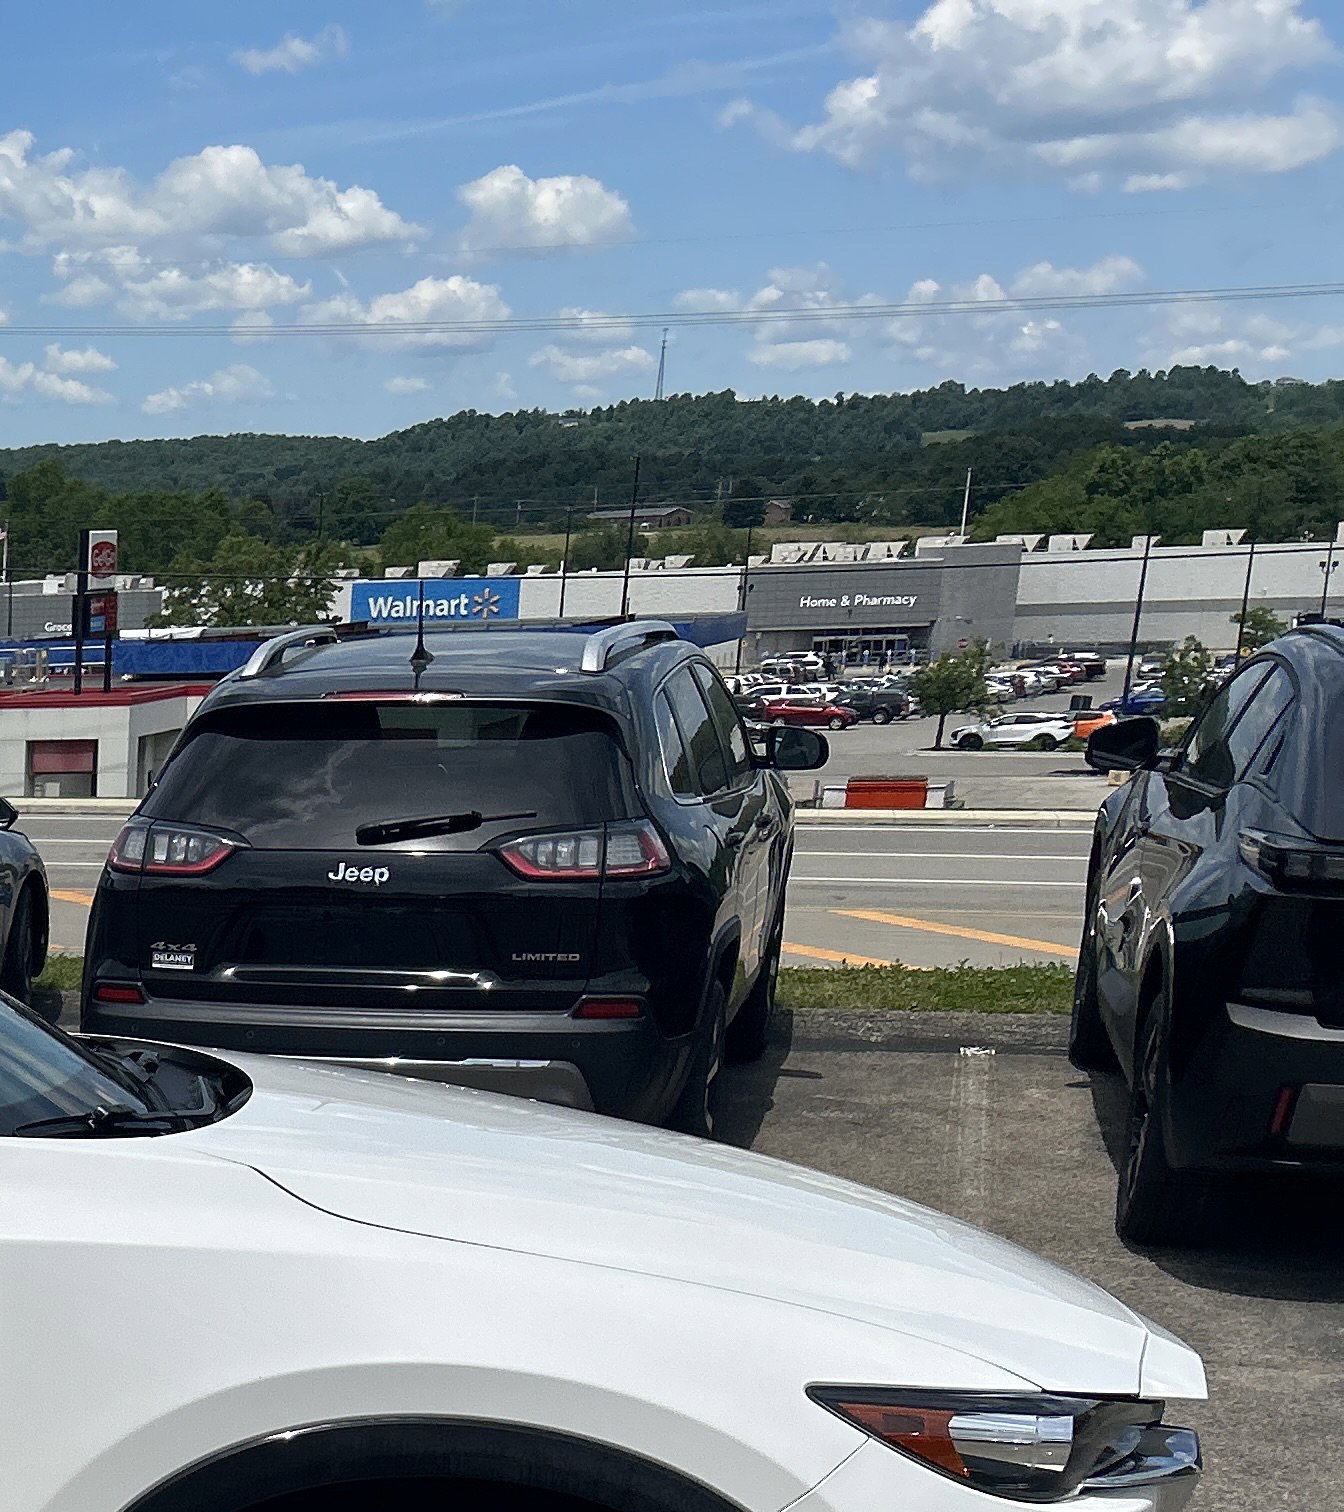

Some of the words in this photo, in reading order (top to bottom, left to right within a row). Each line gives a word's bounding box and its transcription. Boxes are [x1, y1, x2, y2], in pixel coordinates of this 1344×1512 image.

[368, 593, 469, 618] Walmart
[799, 596, 837, 608] Home
[840, 595, 850, 607] &
[854, 594, 918, 608] Pharmacy
[328, 862, 390, 887] Jeep
[150, 941, 197, 951] 4x4
[154, 953, 192, 965] DELANEY
[512, 953, 580, 961] LIMITED
